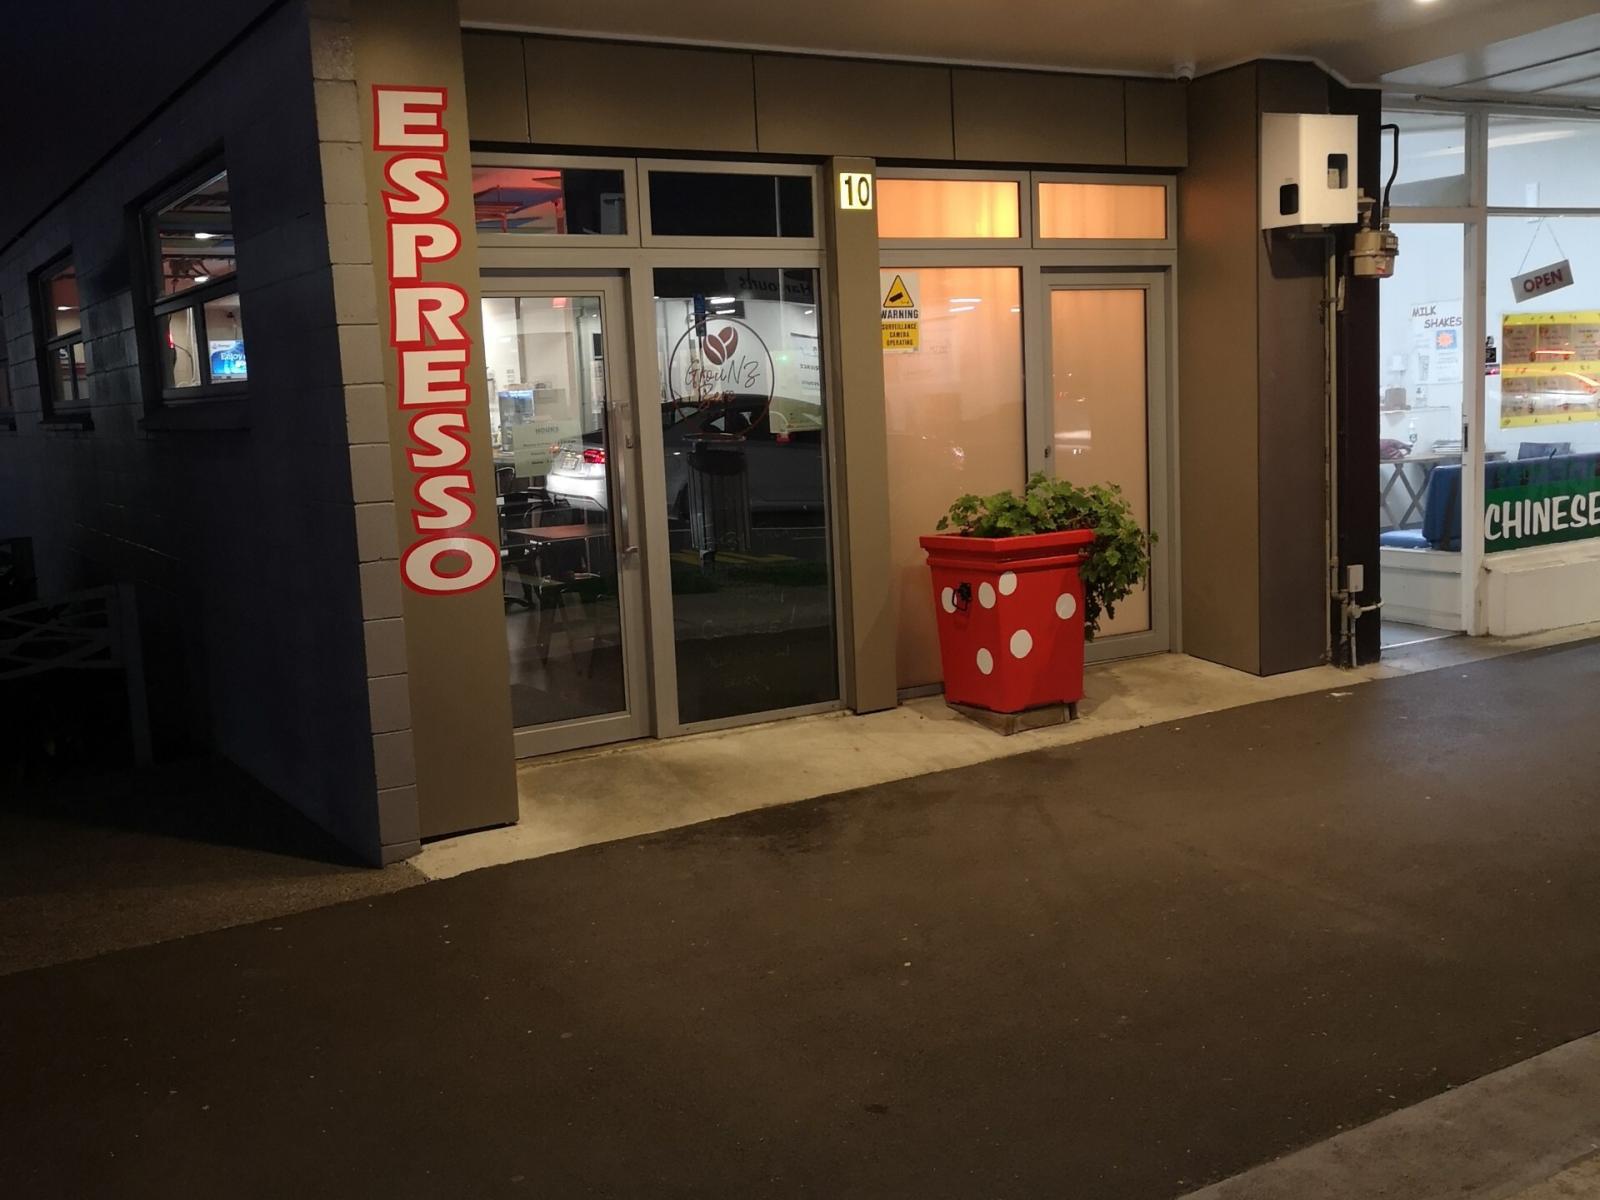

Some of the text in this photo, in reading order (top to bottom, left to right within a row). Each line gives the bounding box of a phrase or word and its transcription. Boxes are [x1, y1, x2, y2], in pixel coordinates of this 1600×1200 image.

[844, 174, 870, 207] 10
[1523, 269, 1563, 292] OPEN
[881, 309, 919, 319] WARNING
[1412, 305, 1437, 317] MILK
[1424, 316, 1462, 329] SHAKES
[372, 84, 498, 595] ESPRESSO
[1484, 491, 1600, 540] CHINESE
